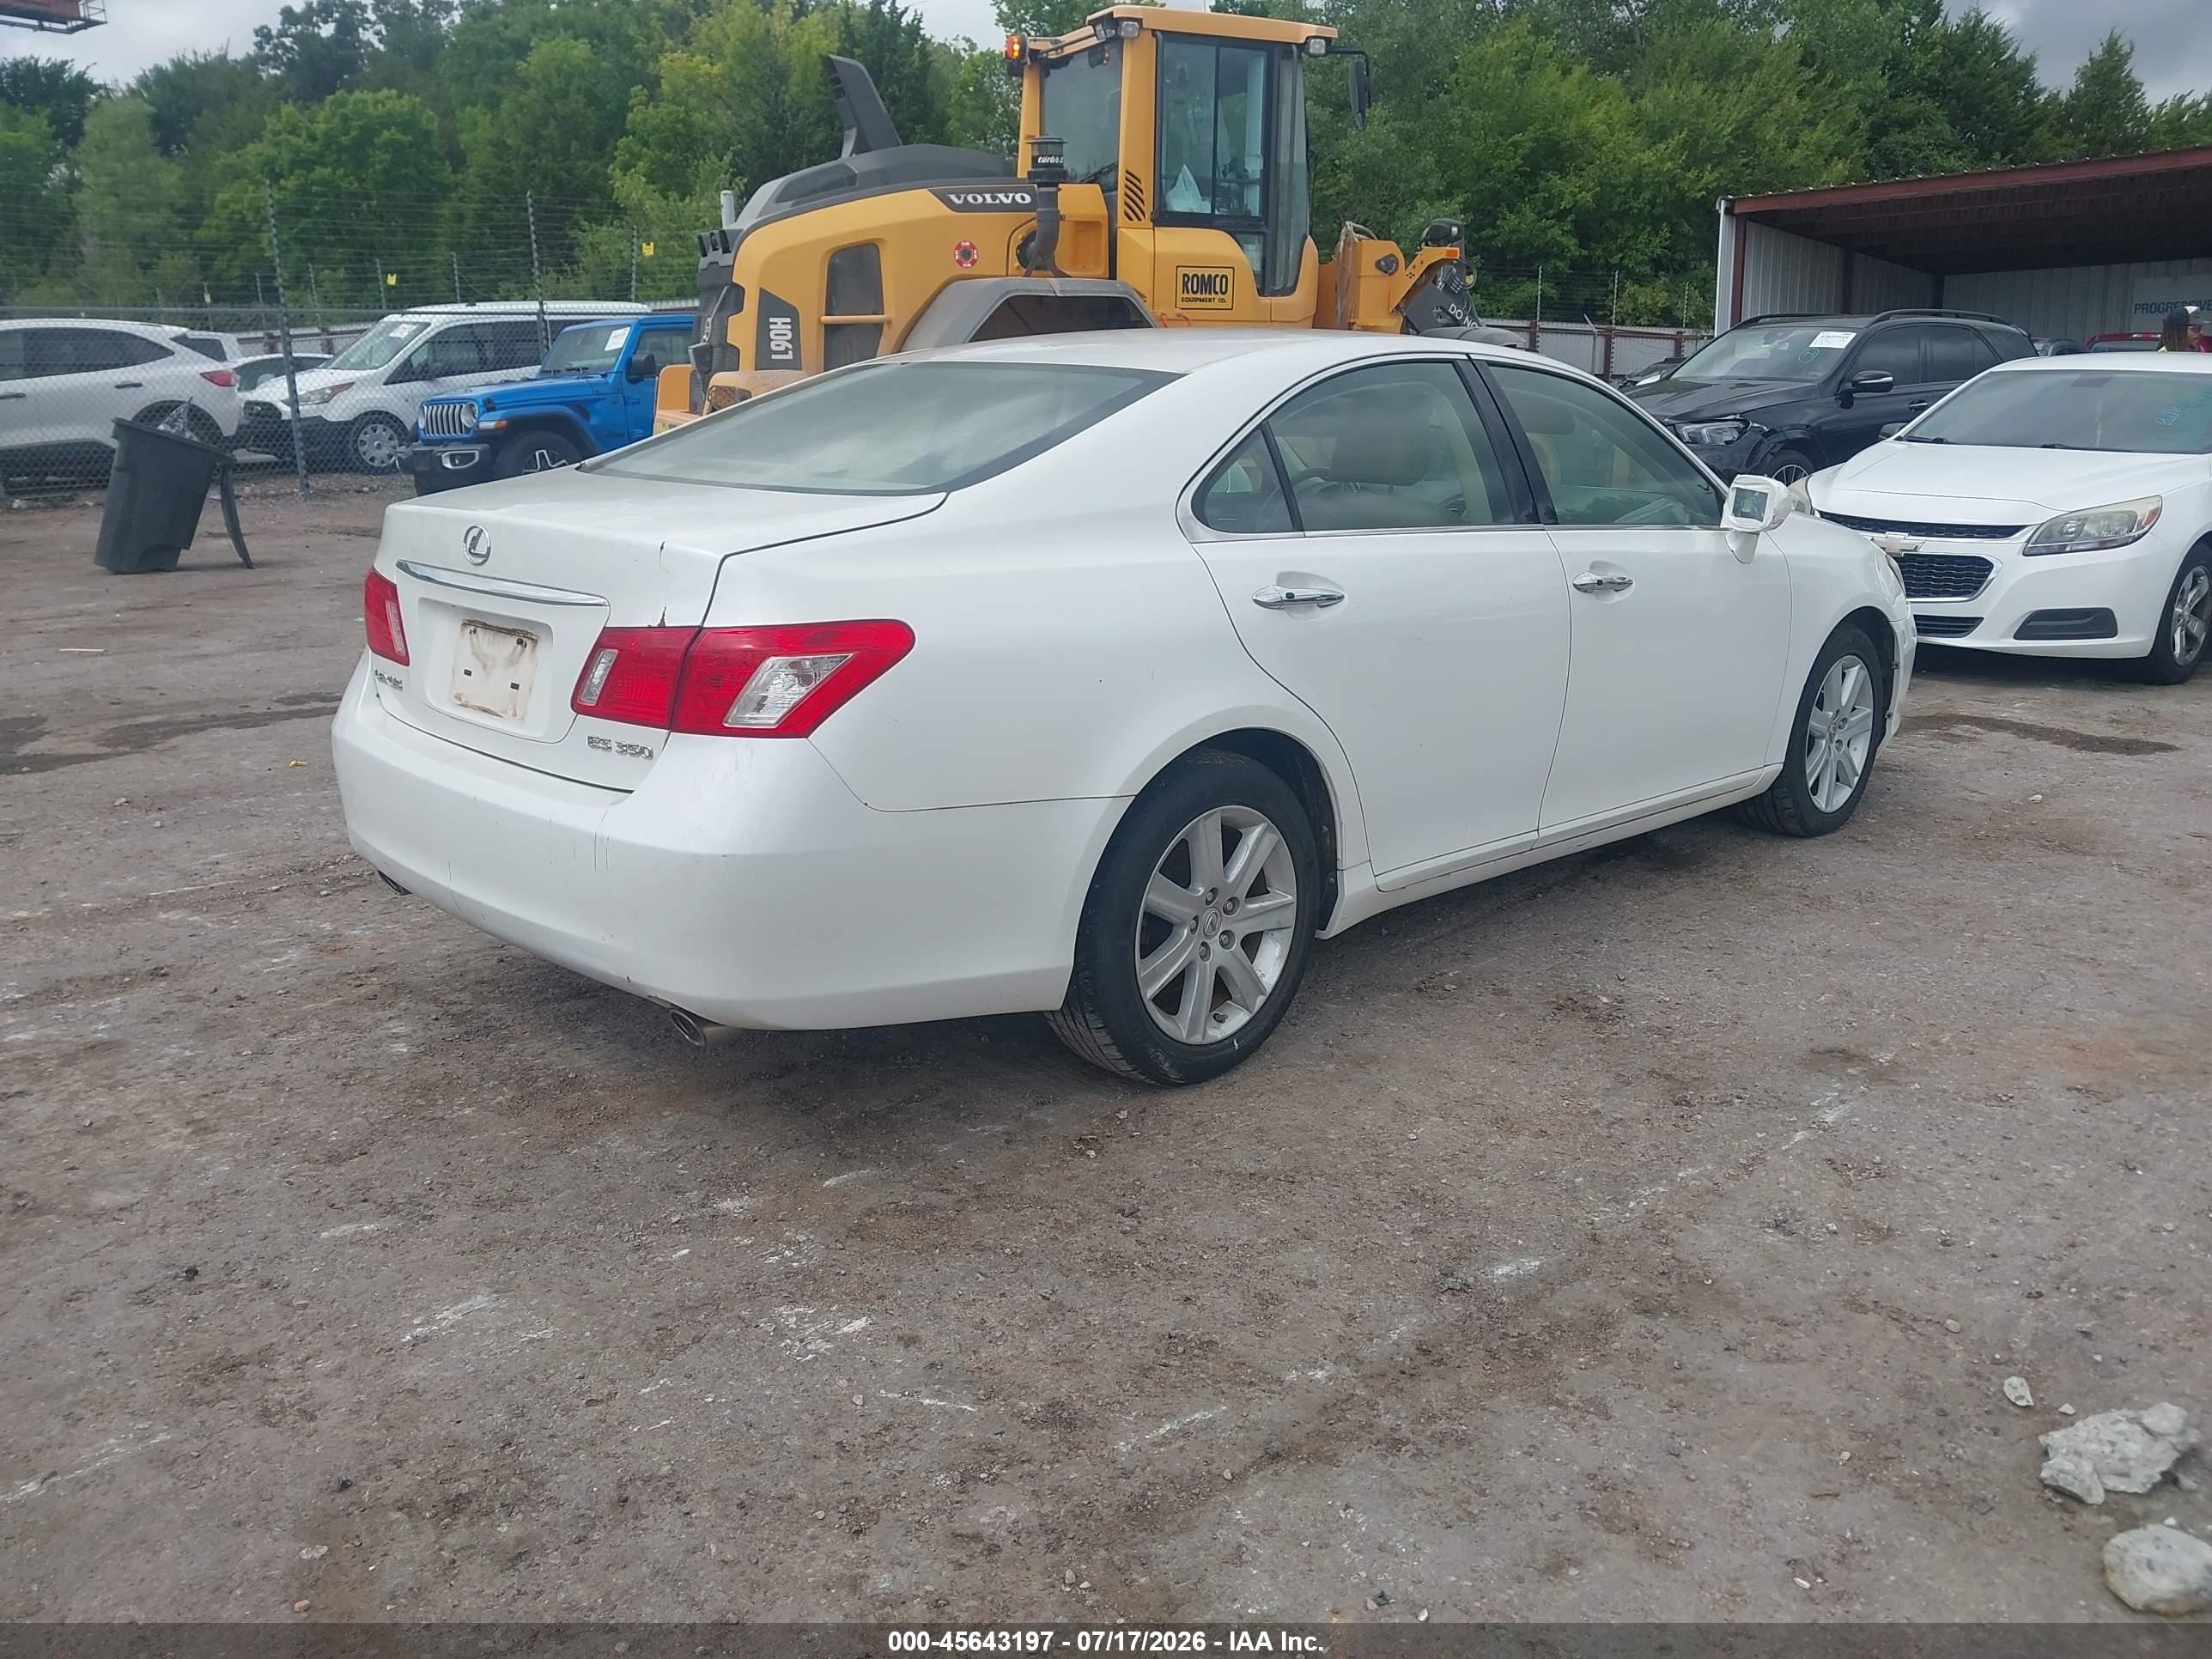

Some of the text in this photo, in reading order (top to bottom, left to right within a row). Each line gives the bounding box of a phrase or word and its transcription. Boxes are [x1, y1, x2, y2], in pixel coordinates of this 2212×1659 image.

[948, 192, 1031, 204] VOLVO
[1182, 273, 1229, 295] ROMCO
[1448, 303, 1463, 320] DO
[769, 317, 793, 360] L90H
[586, 735, 654, 760] ES 350
